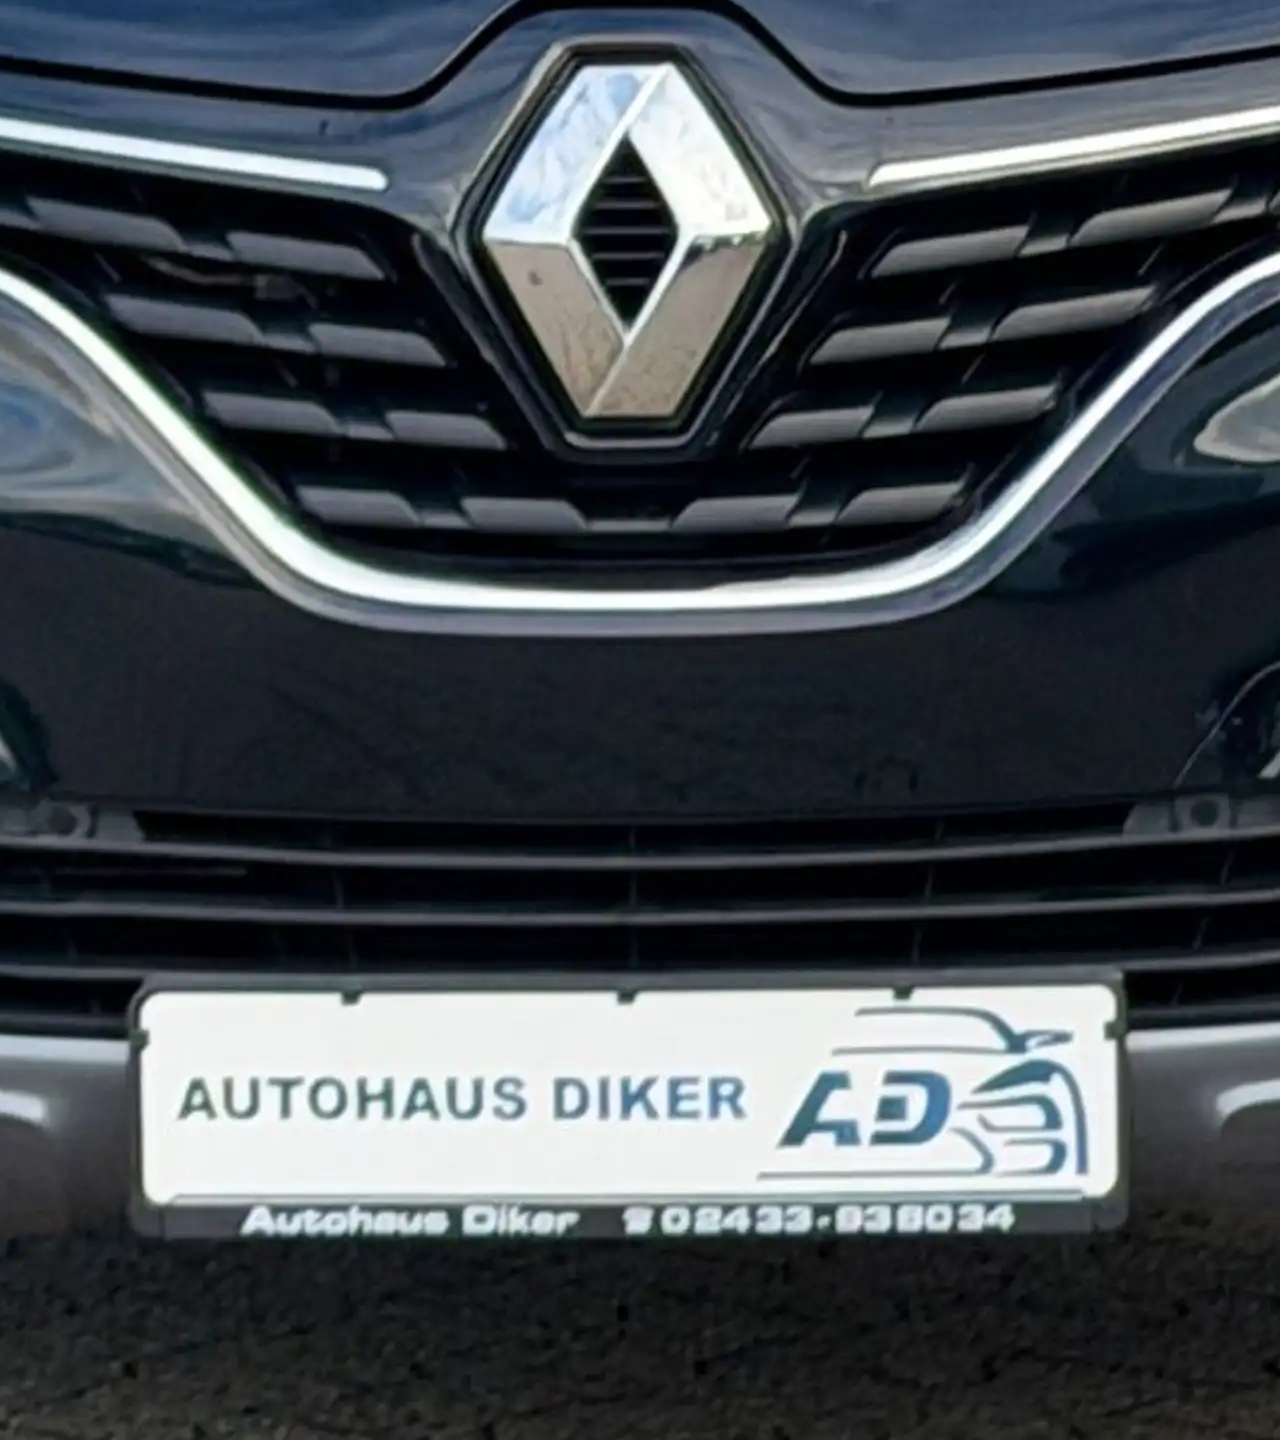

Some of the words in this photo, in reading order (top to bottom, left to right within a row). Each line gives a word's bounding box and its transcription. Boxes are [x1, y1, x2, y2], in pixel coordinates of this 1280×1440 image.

[177, 1075, 527, 1122] AUTOHAUS
[552, 1075, 747, 1121] DIKER
[775, 1069, 952, 1149] AD
[239, 1204, 450, 1236] Autohaus
[461, 1203, 581, 1235] Diker
